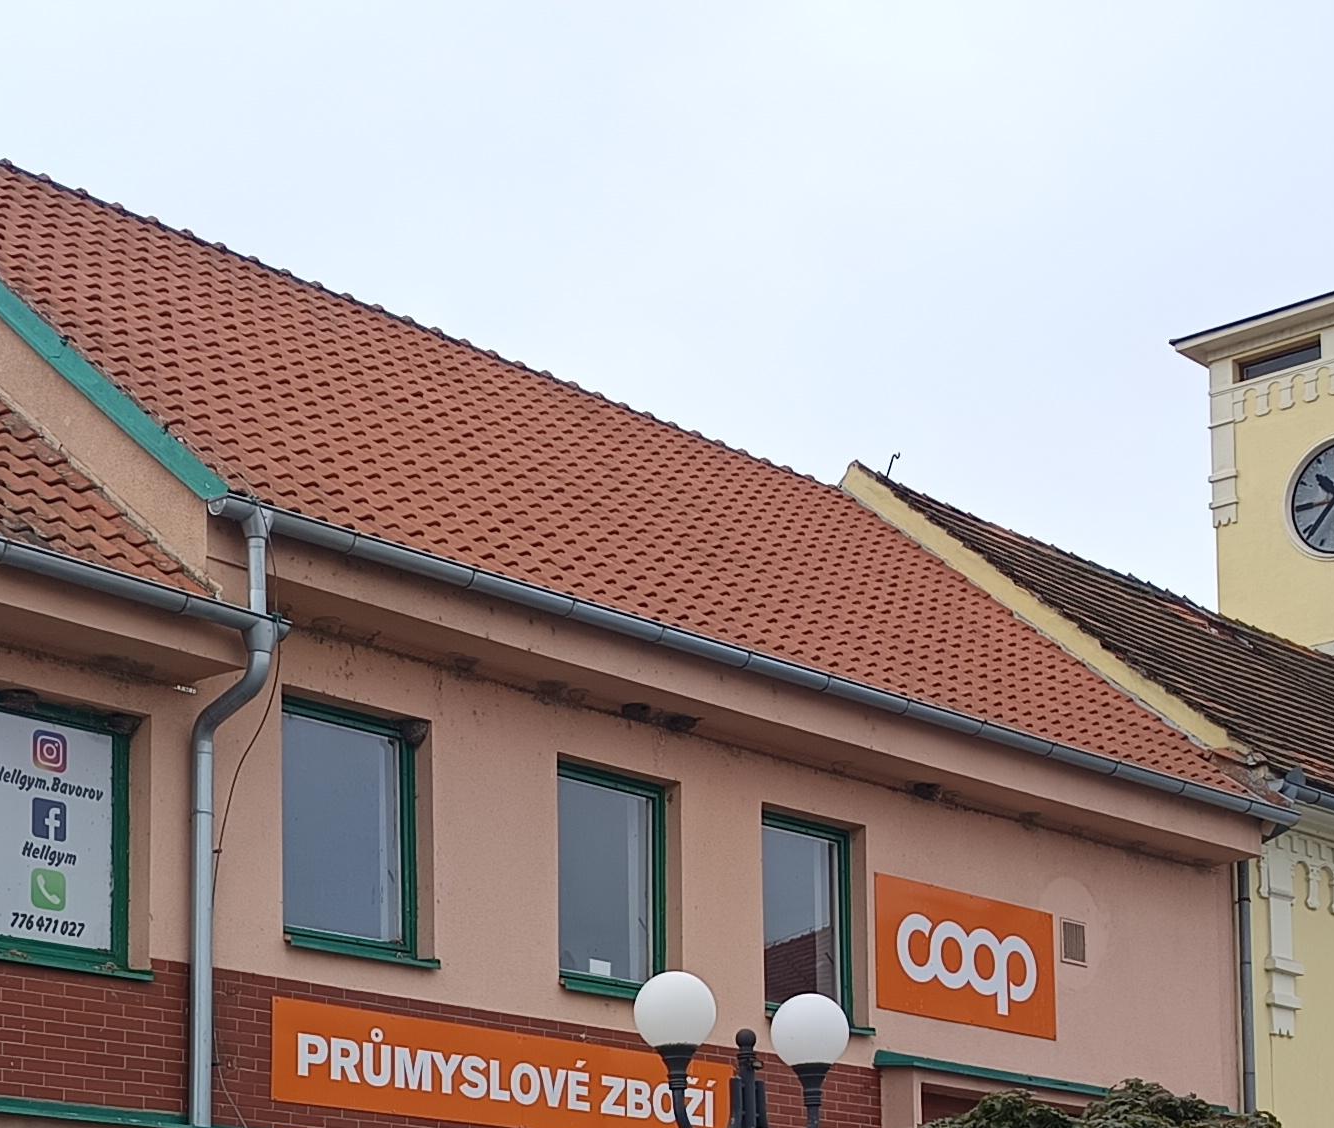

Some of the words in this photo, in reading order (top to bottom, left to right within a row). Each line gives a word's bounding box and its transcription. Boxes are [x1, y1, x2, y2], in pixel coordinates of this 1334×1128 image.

[21, 841, 77, 867] Hellgym
[896, 913, 1038, 1016] coop
[297, 1028, 591, 1112] PRŮMYSLOVÉ
[600, 1075, 716, 1128] ZBOŽÍ
